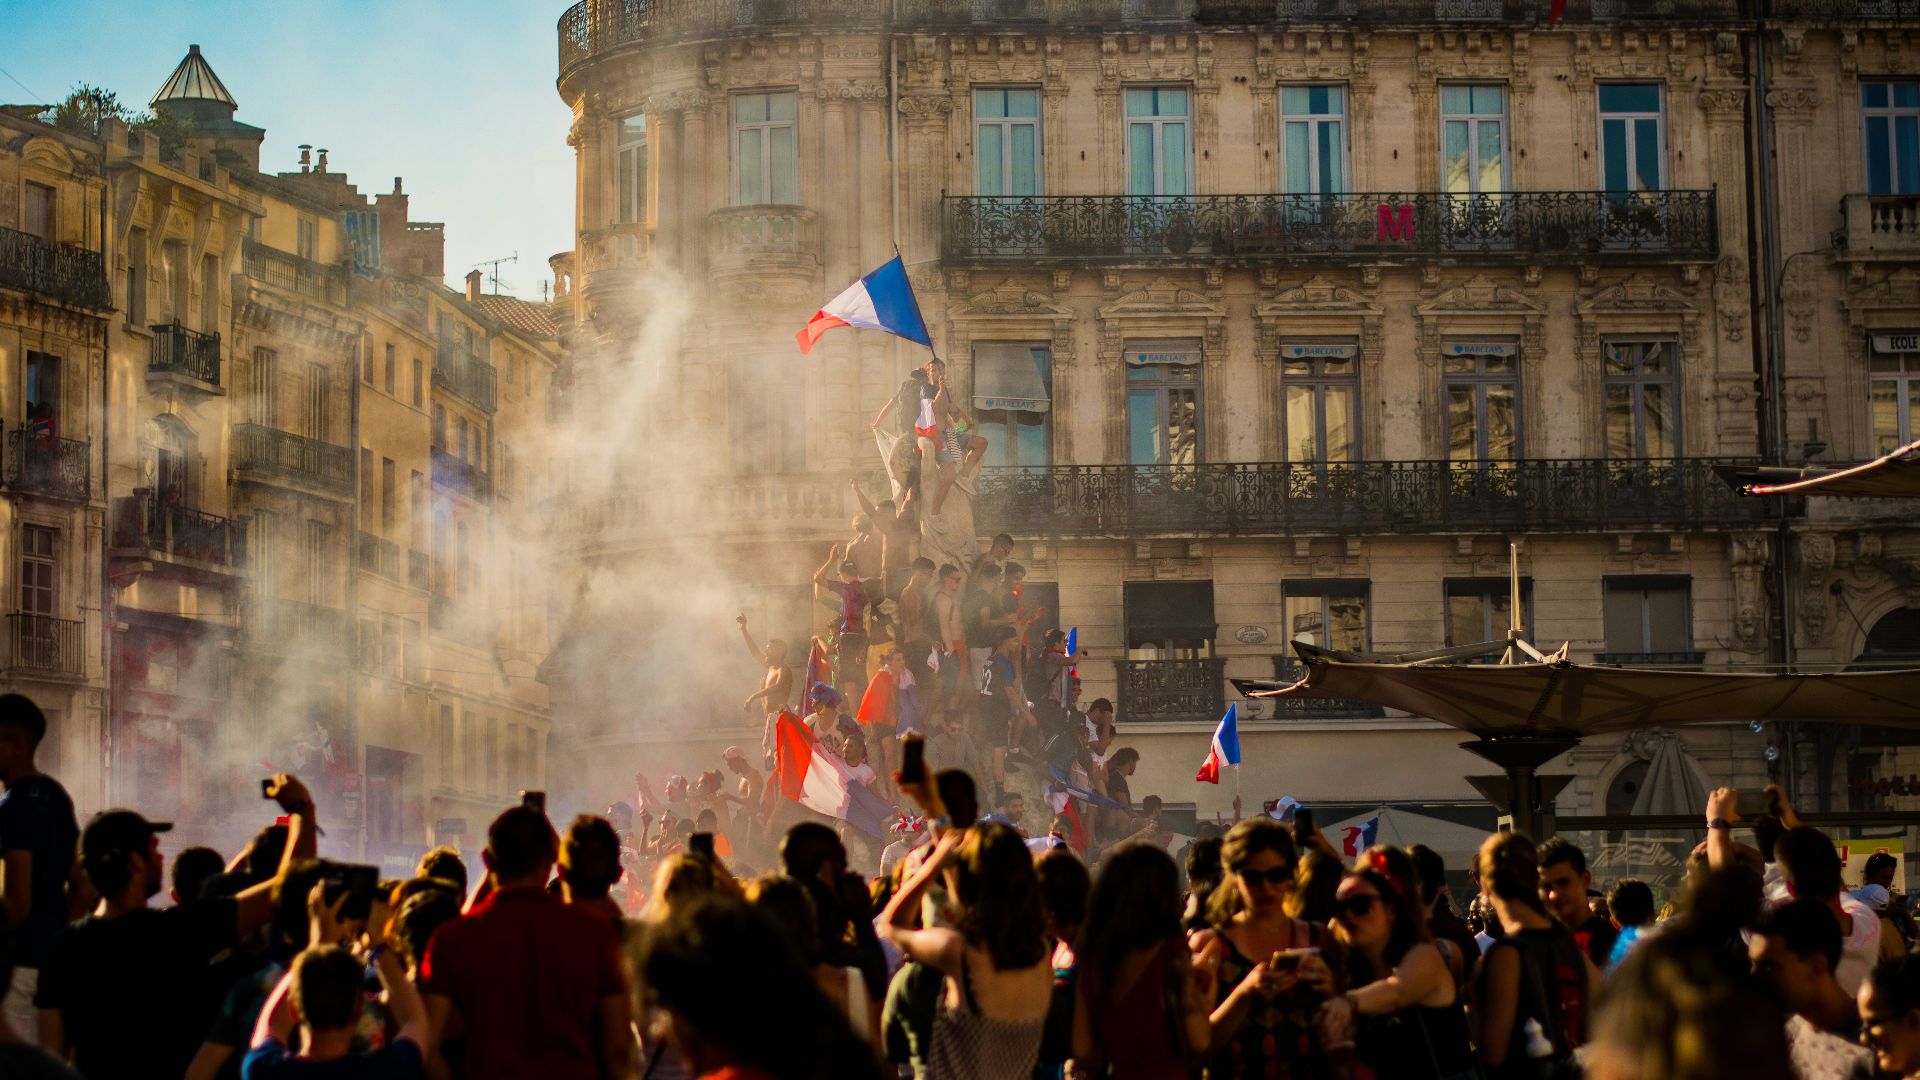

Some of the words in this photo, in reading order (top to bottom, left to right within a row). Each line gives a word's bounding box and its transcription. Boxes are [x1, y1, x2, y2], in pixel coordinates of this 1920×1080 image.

[1378, 203, 1414, 241] M
[1890, 336, 1918, 349] ECOLE
[1304, 347, 1344, 355] BARCLAYS
[1464, 345, 1504, 353] BARCLAYS
[1148, 353, 1187, 362] BARCLAYS
[995, 400, 1036, 409] BARCLAYS
